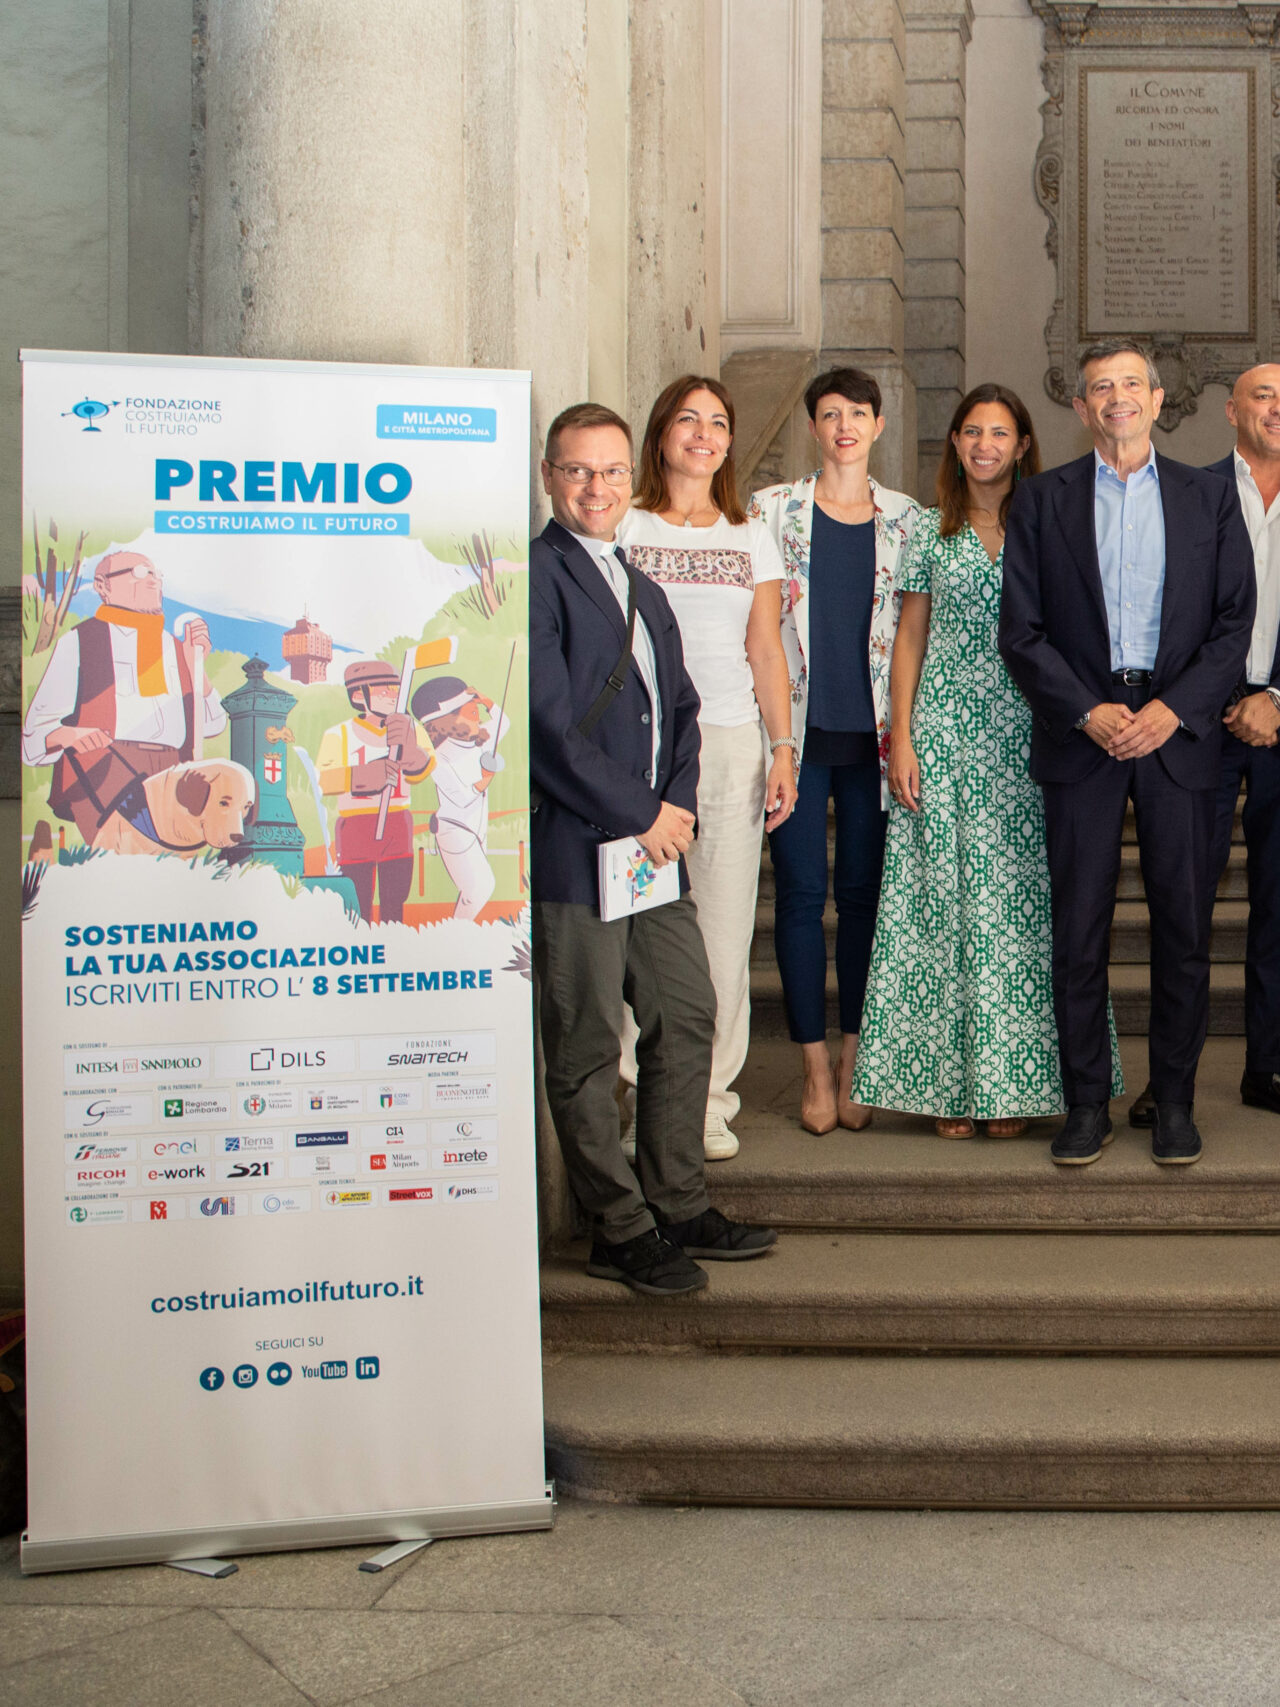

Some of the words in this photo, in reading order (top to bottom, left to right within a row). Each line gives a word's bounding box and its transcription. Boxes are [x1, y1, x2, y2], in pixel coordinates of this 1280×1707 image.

[1130, 88, 1142, 98] IL
[1165, 106, 1179, 114] ED
[1159, 122, 1185, 131] NOMI
[125, 397, 222, 411] FONDAZIONE
[125, 410, 222, 424] COSTRUIAMO
[403, 411, 472, 426] MILANO
[125, 423, 136, 434] IL
[140, 423, 199, 436] FUTURO
[384, 426, 389, 434] E
[392, 424, 416, 434] CITTÀ
[418, 427, 490, 437] METROPOLITANA
[154, 458, 413, 505] PREMIO
[167, 515, 296, 531] COSTRUIAMO
[303, 517, 317, 531] IL
[325, 517, 398, 532] FUTURO
[65, 920, 258, 947] SOSTENIAMO
[65, 956, 103, 977] LA
[108, 954, 169, 976] TUA
[173, 944, 386, 973] ASSOCIAZIONE
[66, 981, 181, 1006] ISCRIVITI
[190, 977, 279, 1001] ENTRO
[312, 975, 329, 996] 8
[337, 969, 493, 996] SETTEMBRE
[405, 1039, 452, 1048] FONDAZIONE
[281, 1050, 326, 1068] DILS
[76, 1062, 118, 1074] INTESA
[185, 1099, 218, 1108] Regione
[185, 1106, 227, 1114] Lombardia
[386, 1126, 404, 1136] CIA
[154, 1138, 197, 1156] enel
[242, 1136, 274, 1146] Terna
[443, 1148, 488, 1163] inrete
[392, 1160, 419, 1169] Airports
[77, 1169, 126, 1180] RICOH
[148, 1164, 205, 1180] e-work
[461, 1187, 477, 1195] DHS
[151, 1275, 424, 1314] costruiamoilfuturo.it
[255, 1337, 305, 1351] SEGUICI
[308, 1336, 324, 1347] SU
